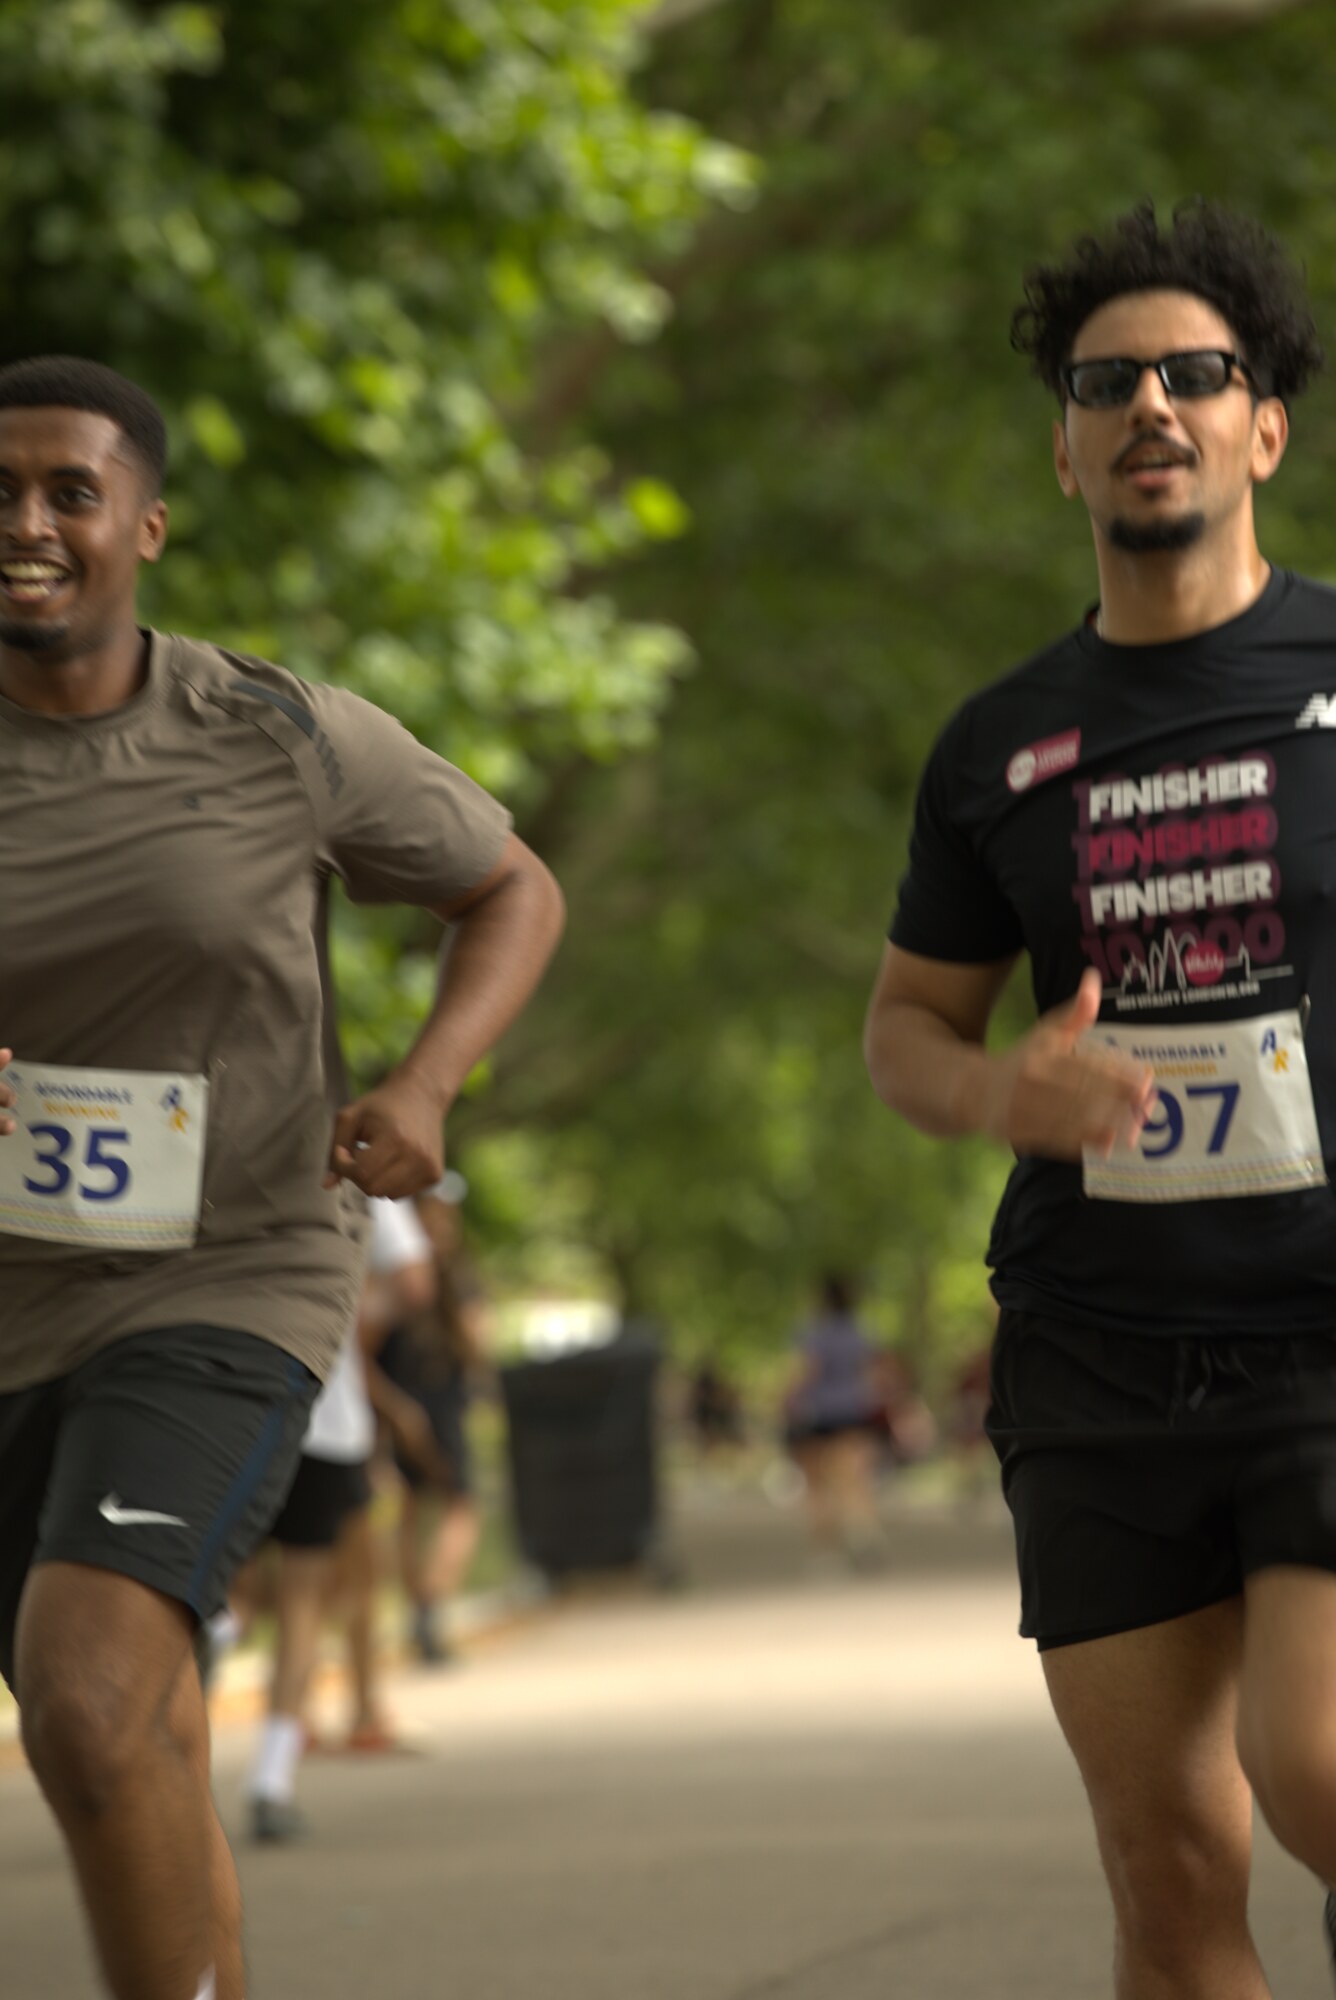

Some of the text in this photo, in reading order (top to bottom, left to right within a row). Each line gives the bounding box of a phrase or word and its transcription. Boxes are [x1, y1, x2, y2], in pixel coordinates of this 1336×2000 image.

[1089, 758, 1268, 823] FINISHER
[1088, 808, 1270, 869] FINISHER
[1090, 860, 1273, 925] FINISHER
[1142, 1081, 1240, 1160] 97
[23, 1122, 131, 1202] 35
